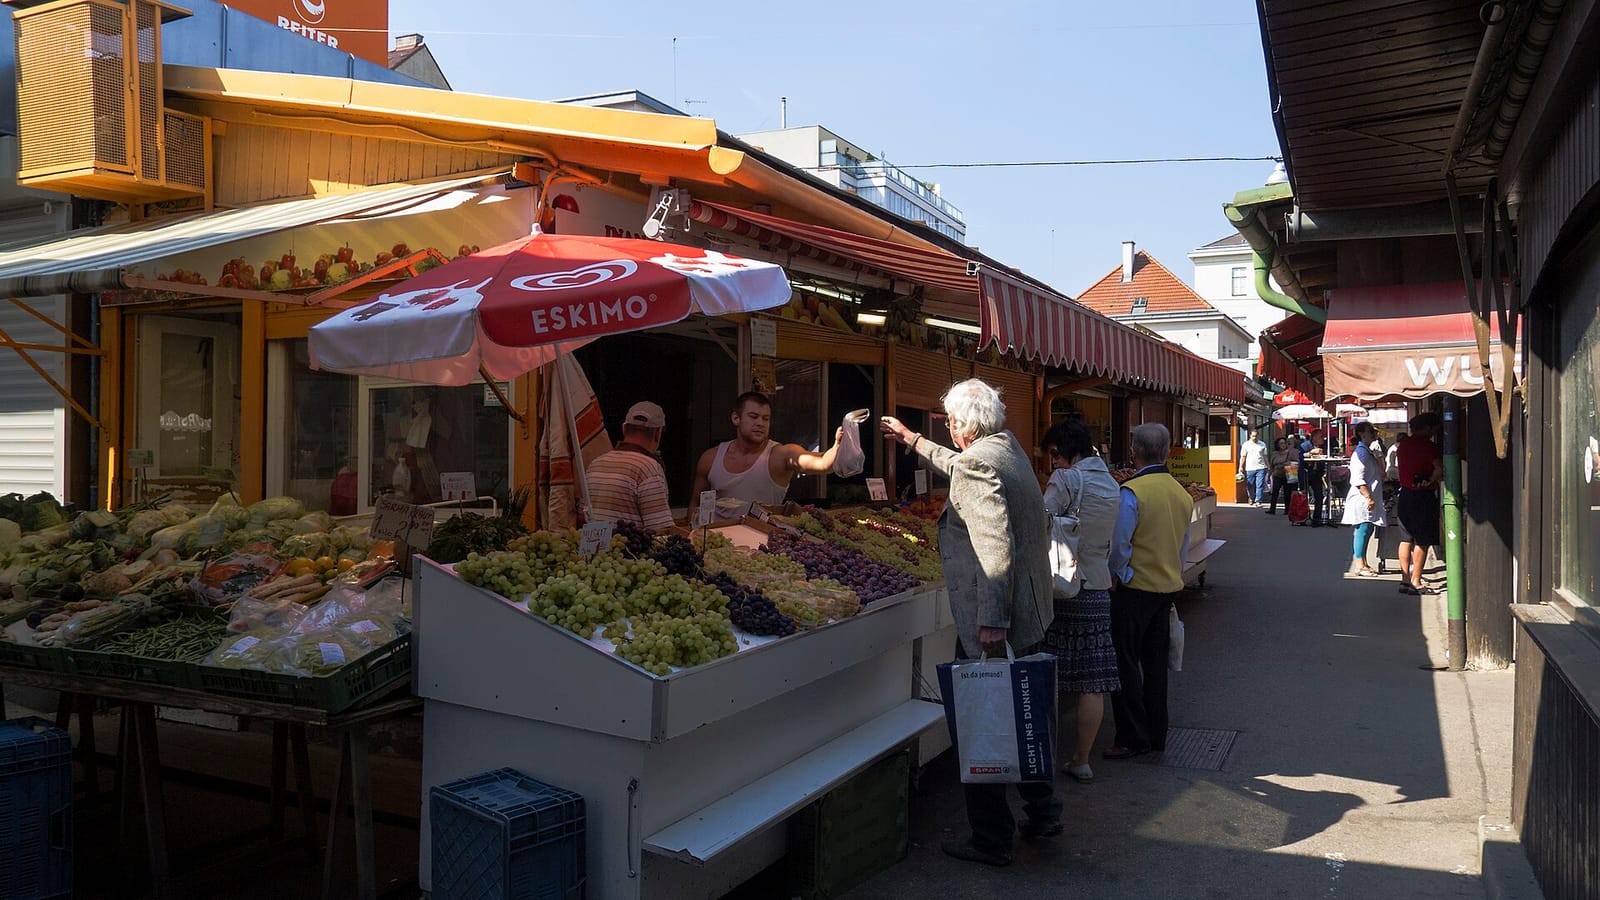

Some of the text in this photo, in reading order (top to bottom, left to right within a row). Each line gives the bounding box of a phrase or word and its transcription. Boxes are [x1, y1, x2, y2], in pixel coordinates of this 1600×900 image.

[277, 15, 338, 48] REITER
[531, 295, 648, 334] ESKIMO
[1404, 355, 1521, 386] WU
[1171, 462, 1203, 470] Sauerkraut
[970, 670, 978, 678] da
[979, 670, 1004, 680] jemand?
[1020, 676, 1038, 775] LICHT INS DUNKEL
